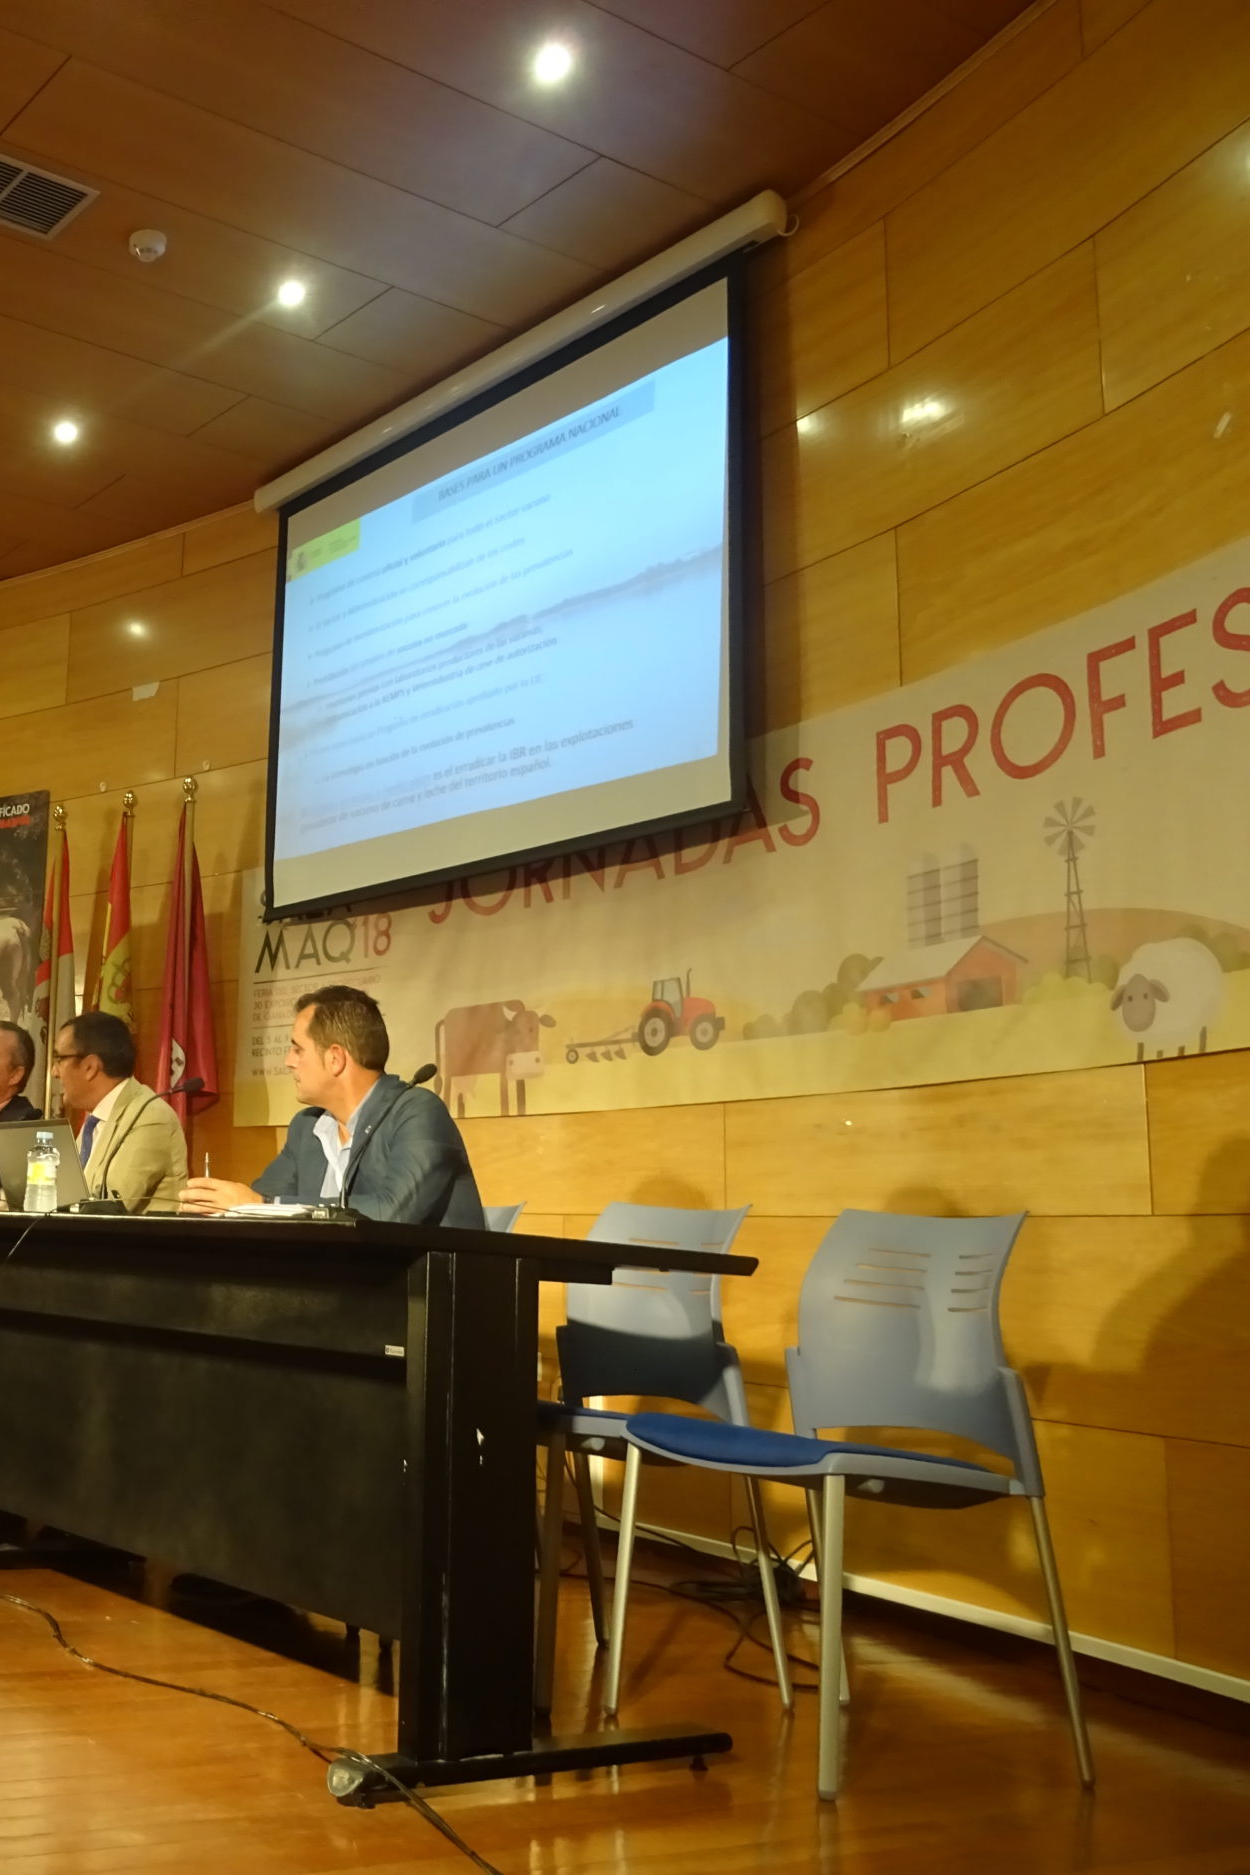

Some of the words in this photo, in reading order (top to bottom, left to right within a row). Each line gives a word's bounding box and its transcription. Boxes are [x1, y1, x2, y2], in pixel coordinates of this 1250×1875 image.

[438, 480, 463, 500] BASES
[466, 468, 491, 486] PARA
[492, 461, 507, 474] UN
[509, 433, 565, 466] PROGRAMA
[568, 406, 622, 437] NACIONAL
[454, 756, 495, 773] erradicar
[498, 752, 506, 762] la
[560, 720, 633, 746] explotaciones
